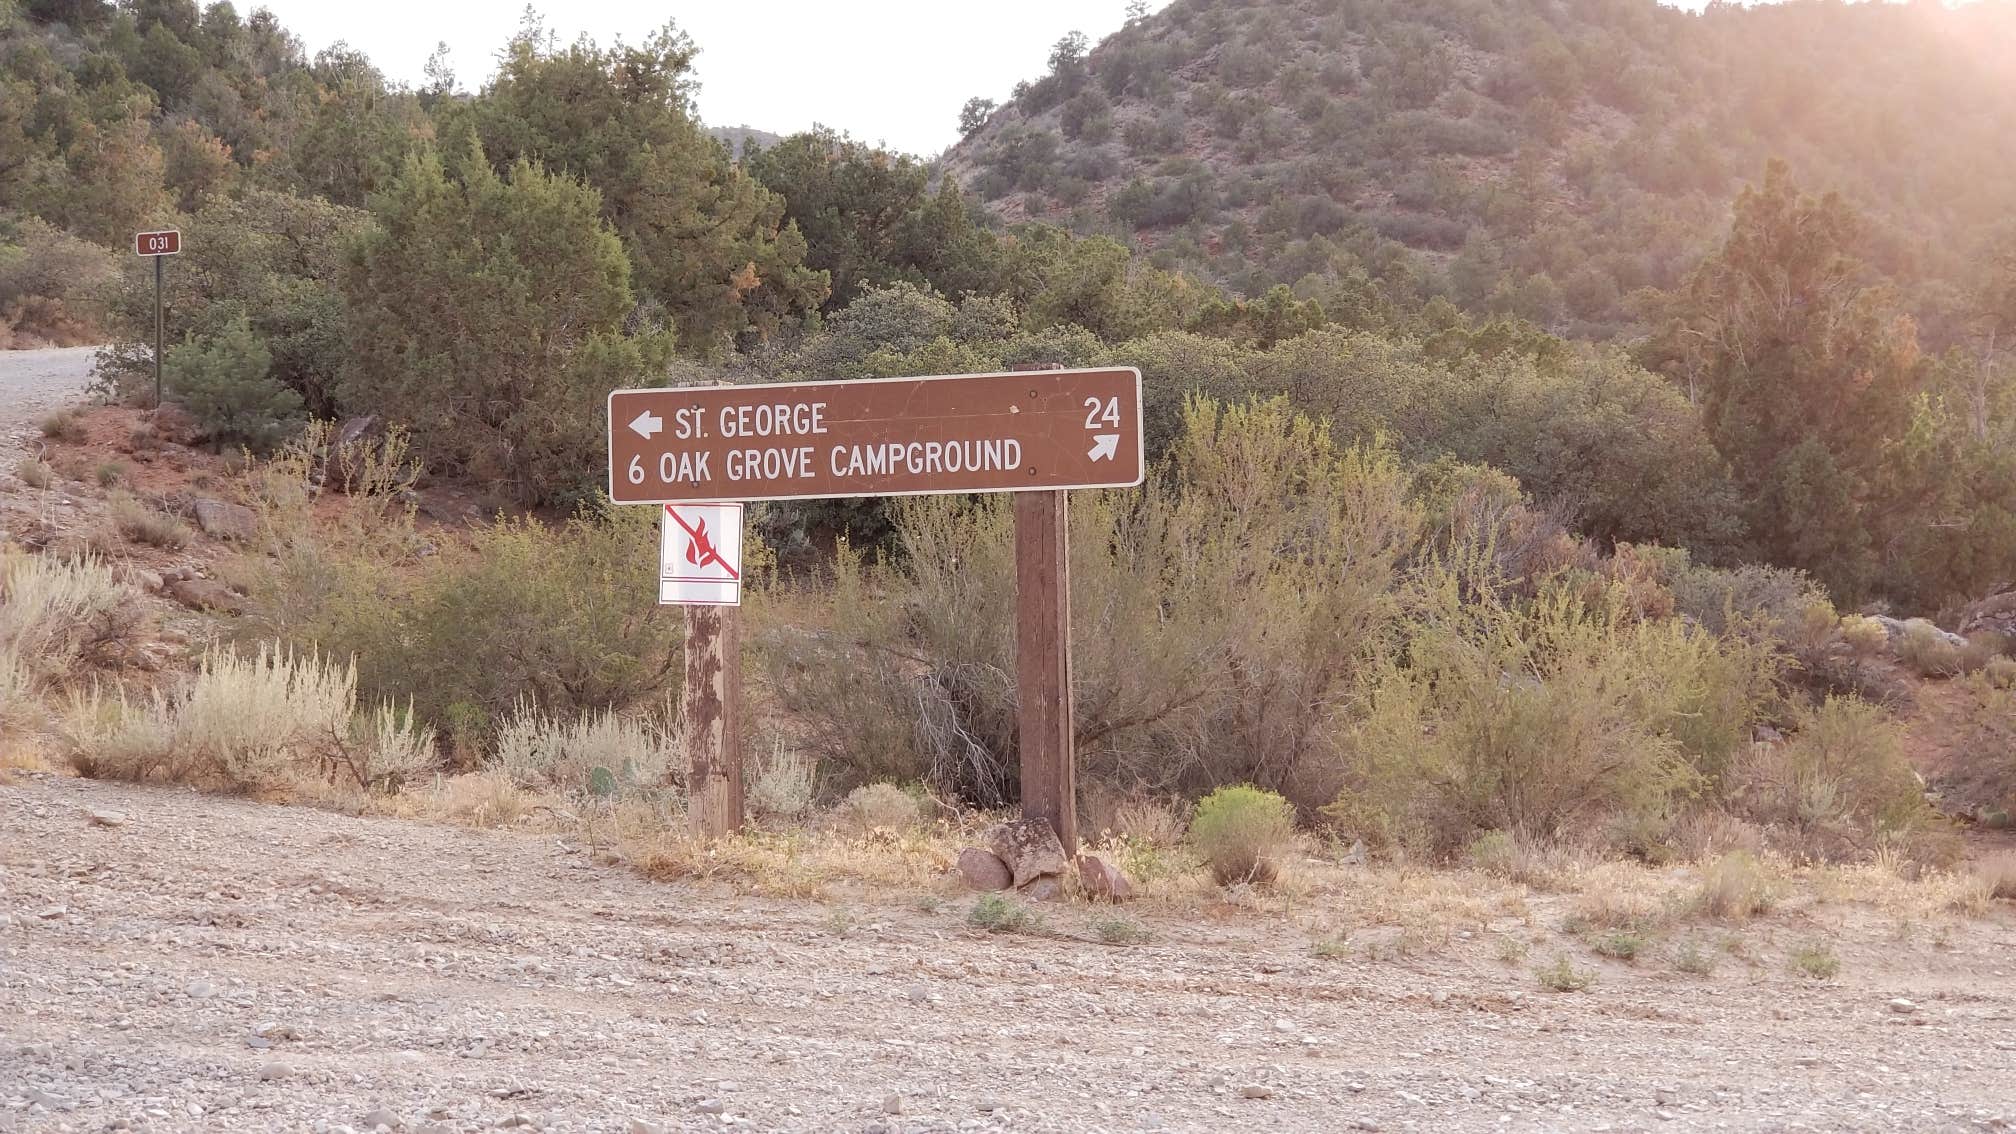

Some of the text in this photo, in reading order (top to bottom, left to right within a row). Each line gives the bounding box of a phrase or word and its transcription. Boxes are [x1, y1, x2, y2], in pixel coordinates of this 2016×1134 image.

[149, 236, 169, 250] 031
[675, 396, 1121, 440] ST. GEORGE 24
[628, 439, 1022, 485] 6 OAK GROVE CAMPGROUND
